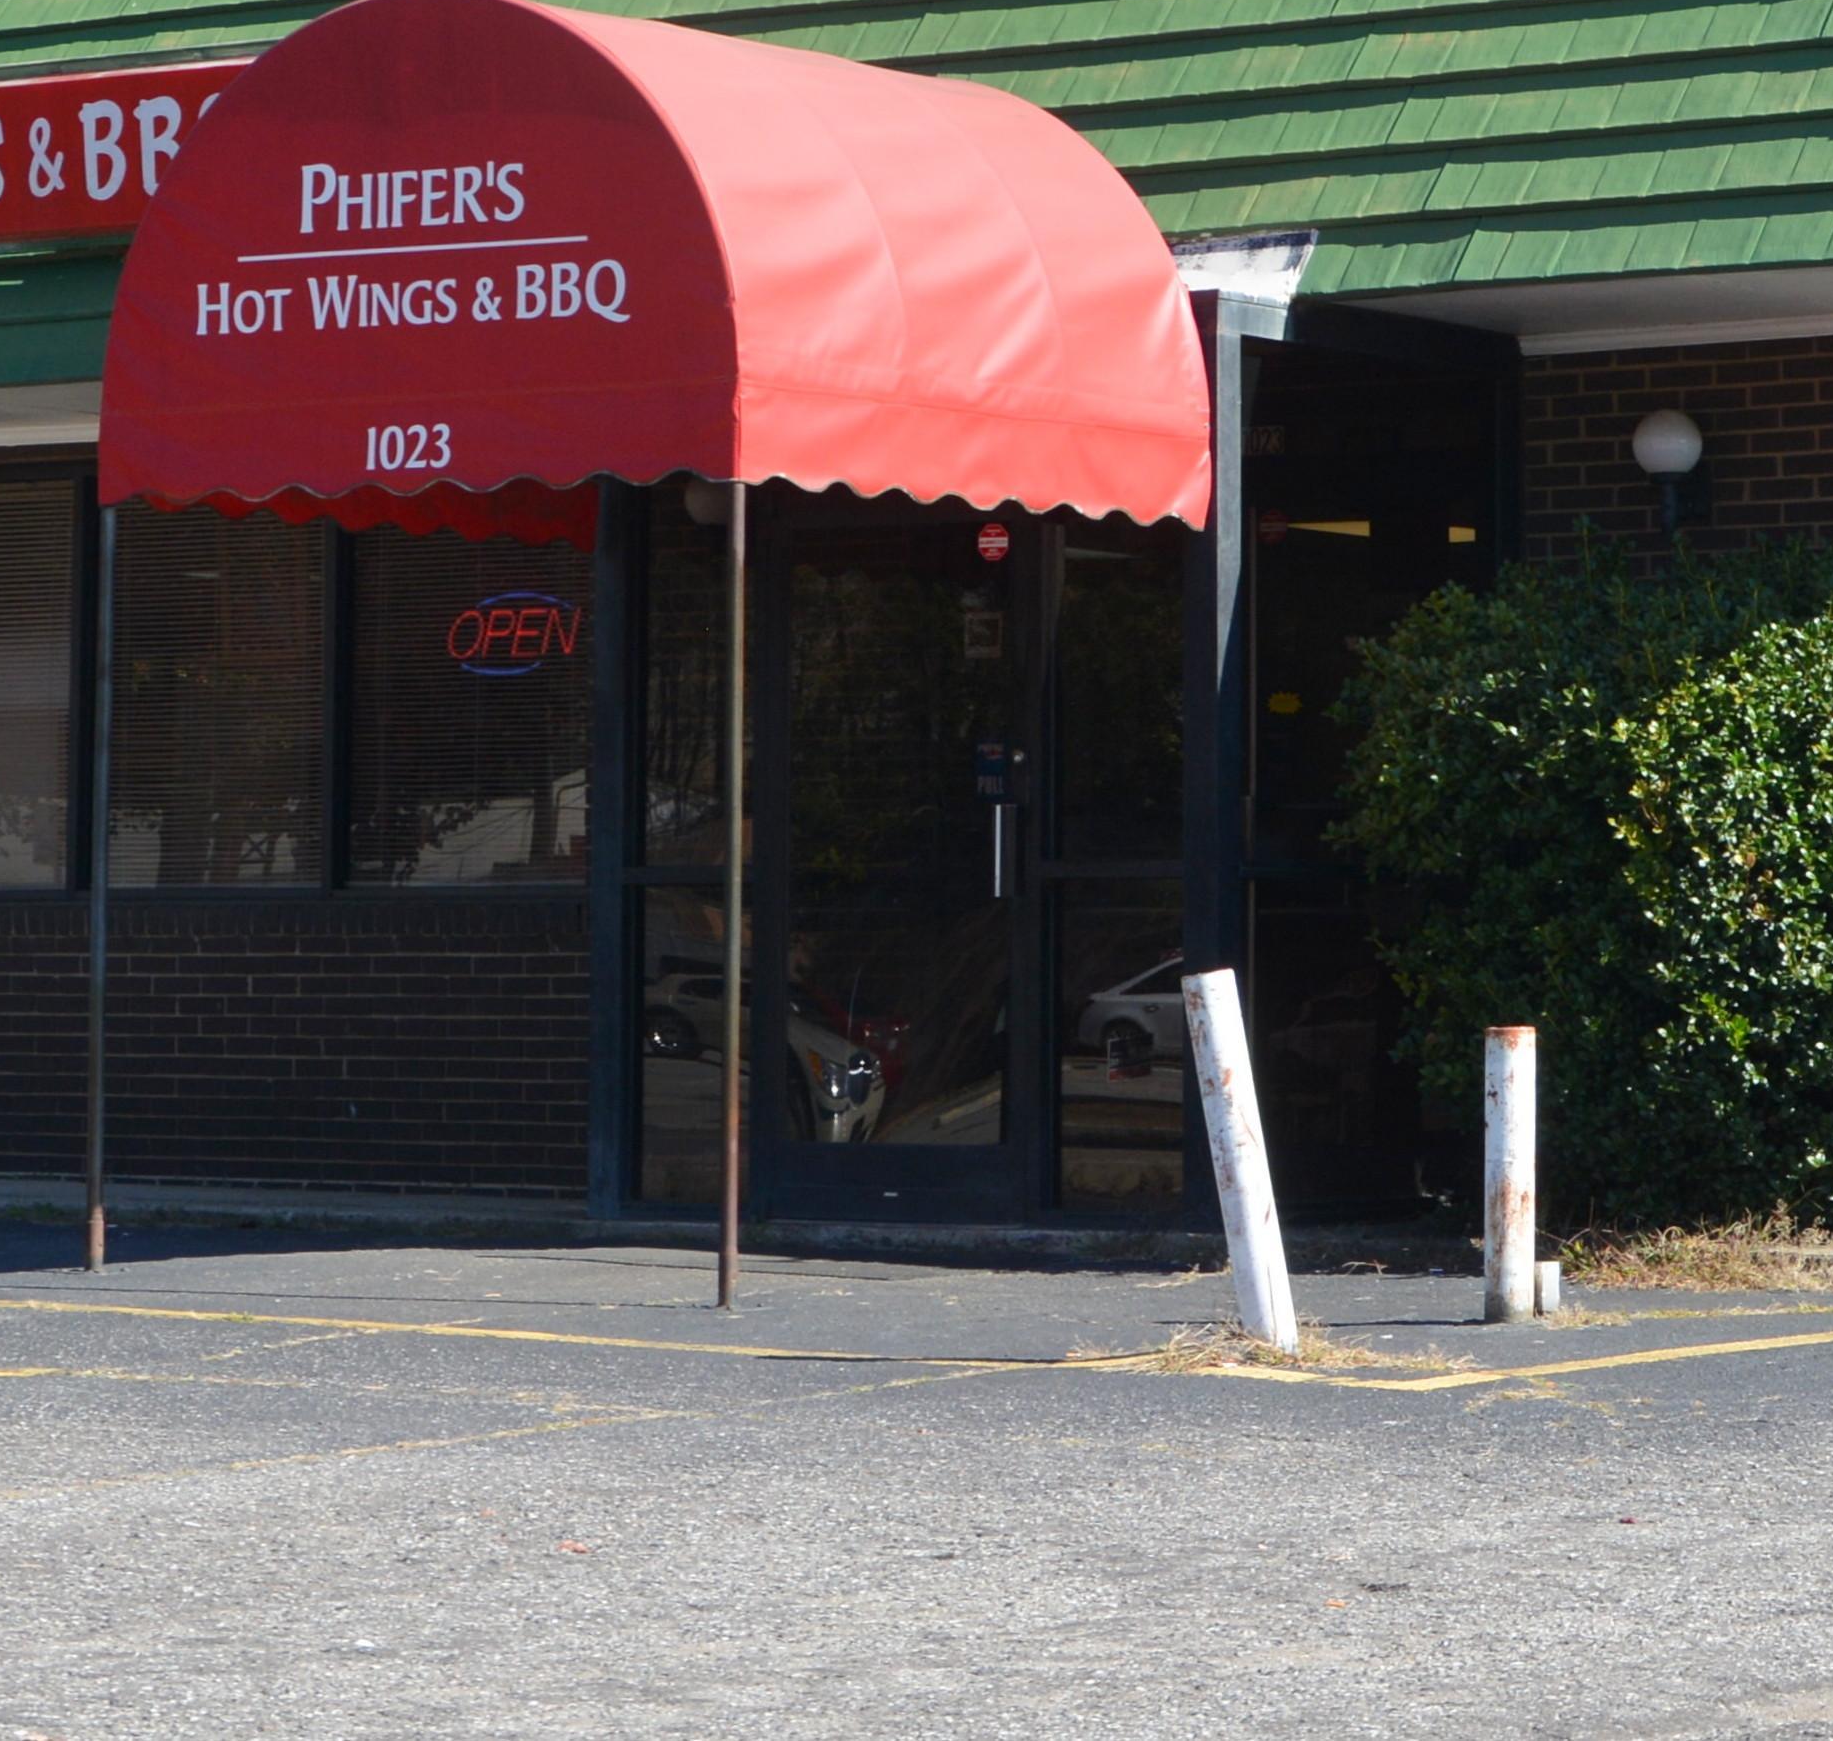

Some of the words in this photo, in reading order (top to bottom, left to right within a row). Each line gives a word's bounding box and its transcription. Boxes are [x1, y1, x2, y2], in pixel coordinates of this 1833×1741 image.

[28, 117, 65, 198] &
[78, 92, 221, 201] BB
[300, 161, 525, 233] PHIFER'S
[196, 282, 292, 335] HOT
[307, 275, 457, 330] WINGS
[472, 276, 502, 322] &
[515, 259, 630, 322] BBQ
[366, 423, 451, 470] 1023
[446, 607, 581, 659] OPEN
